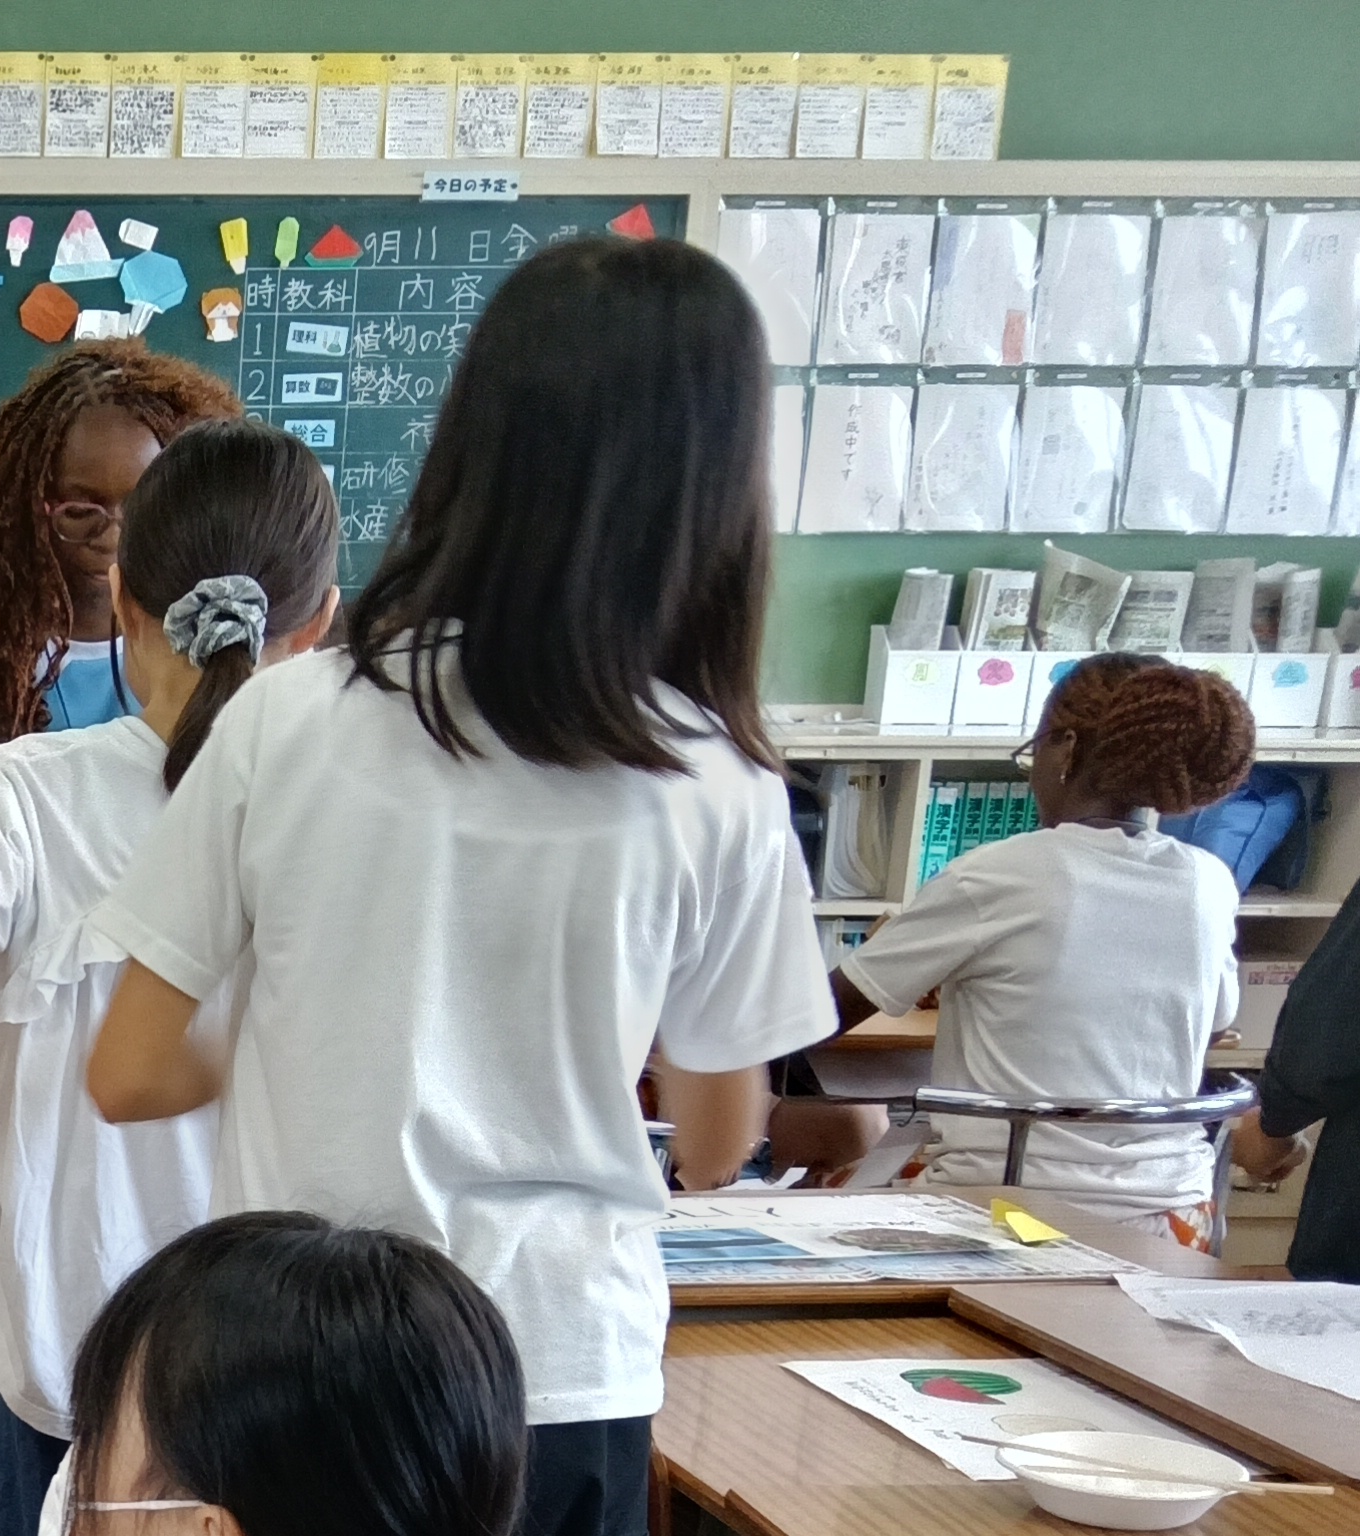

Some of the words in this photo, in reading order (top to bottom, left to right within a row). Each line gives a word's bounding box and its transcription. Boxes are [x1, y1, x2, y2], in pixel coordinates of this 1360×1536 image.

[434, 178, 508, 194] 今日の予定
[247, 283, 276, 309] 時
[281, 279, 353, 312] 教科
[398, 272, 486, 312] 内容
[291, 328, 318, 345] 理科
[247, 370, 266, 401] 2
[285, 379, 311, 394] 算数
[934, 803, 953, 834] 漢字
